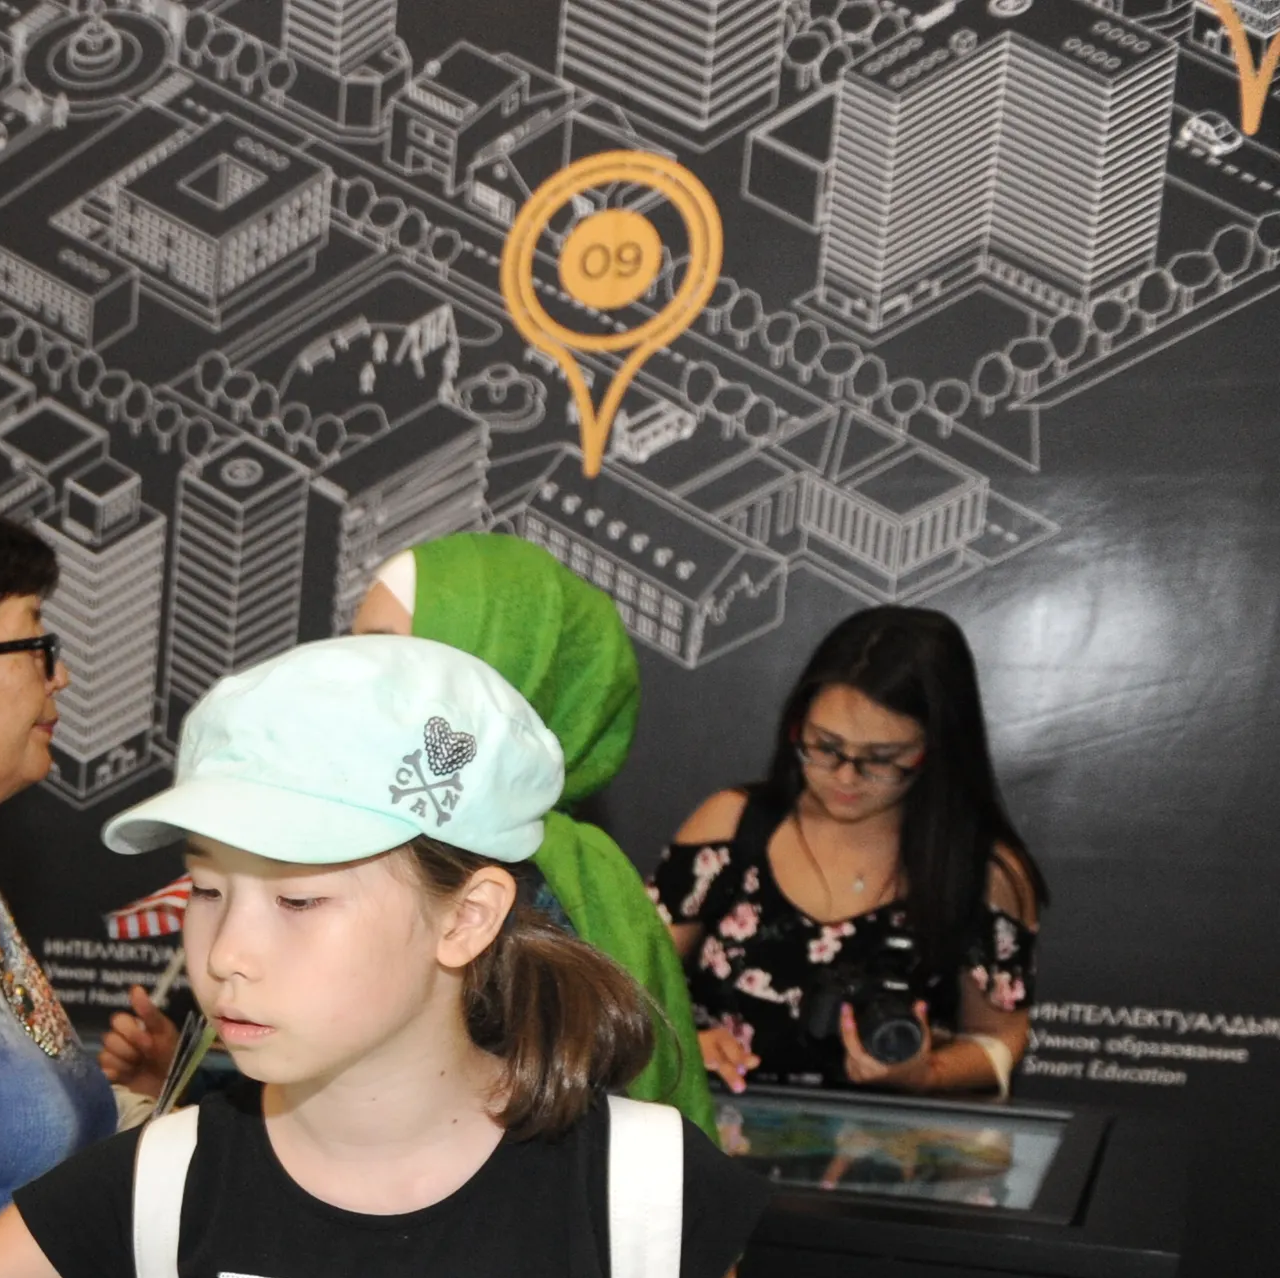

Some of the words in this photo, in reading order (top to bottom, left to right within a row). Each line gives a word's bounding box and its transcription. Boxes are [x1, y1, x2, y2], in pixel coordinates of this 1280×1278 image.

[580, 242, 643, 281] 09
[1023, 1054, 1085, 1079] Smart
[1086, 1058, 1188, 1086] Education
